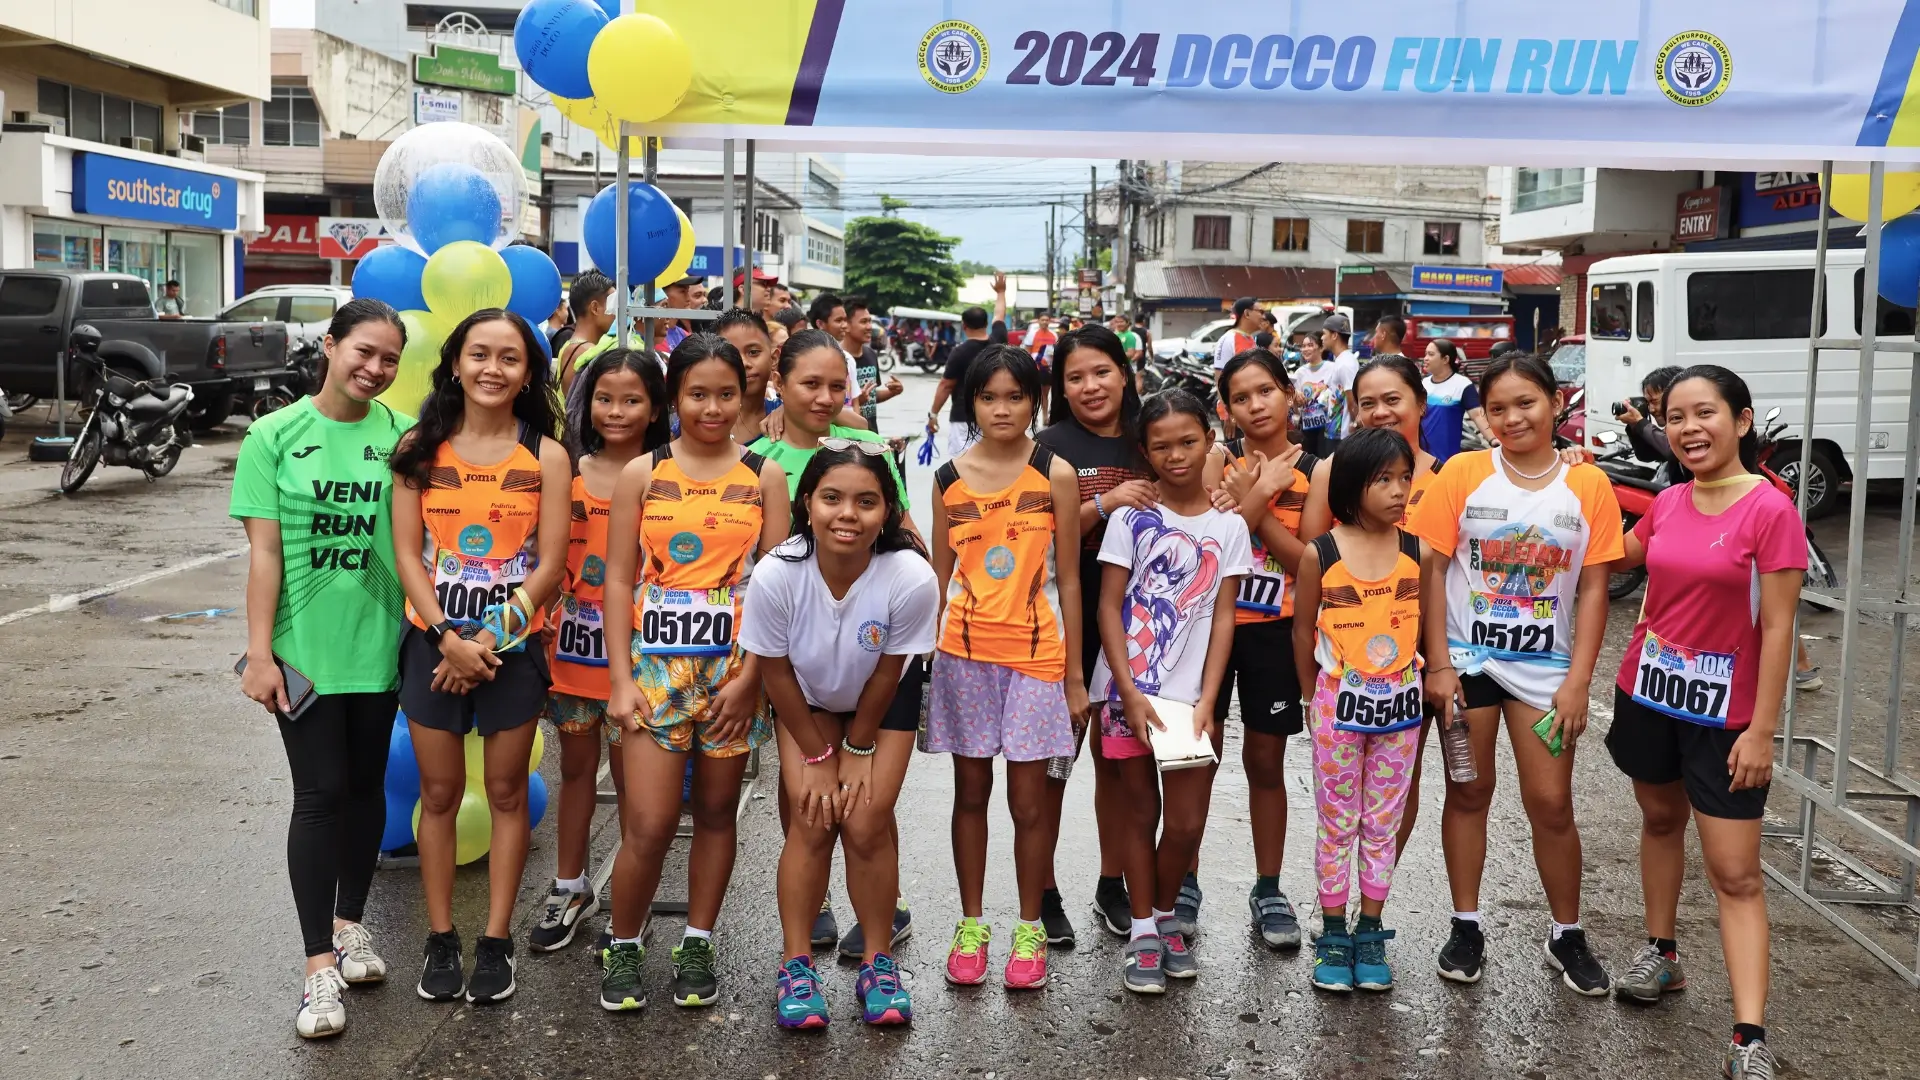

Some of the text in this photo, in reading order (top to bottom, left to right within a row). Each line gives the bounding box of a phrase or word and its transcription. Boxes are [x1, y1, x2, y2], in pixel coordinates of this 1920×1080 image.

[918, 22, 988, 69] DCCCO MULTIPURPOSE COOPERATIVE
[1006, 30, 1639, 95] 2024 DCCCO FUN RUN
[1656, 32, 1730, 82] DCCCO MULTIPURPOSE COOPERATIVE
[927, 76, 978, 92] DUMAGUETE CITY
[1665, 89, 1719, 105] DUMAGUETE CITY
[1773, 188, 1821, 211] AUT
[254, 223, 319, 244] PAL
[1680, 213, 1712, 235] ENTRY
[1420, 272, 1493, 288] MAKO MUSIC
[464, 473, 497, 482] Joma
[1077, 467, 1098, 477] 2020
[311, 480, 383, 503] VENI
[589, 506, 609, 516] Jom
[982, 499, 1011, 512] Joma
[311, 513, 377, 537] RUN
[311, 548, 371, 571] VICI
[465, 559, 483, 567] 2024
[1470, 538, 1480, 571] 2018
[463, 566, 489, 575] DCCCO
[707, 586, 731, 606] 5K
[1237, 574, 1280, 606] 177
[1362, 586, 1392, 598] Joma
[1491, 604, 1517, 612] DCCCO
[1493, 597, 1512, 605] 2024
[1532, 600, 1554, 619] 5K
[643, 610, 733, 646] 05120
[1471, 620, 1554, 653] 05121
[559, 620, 605, 659] 051
[1662, 645, 1678, 655] 2024
[1693, 654, 1731, 678] 10K
[1640, 663, 1728, 718] 10067
[1336, 687, 1421, 727] 05548
